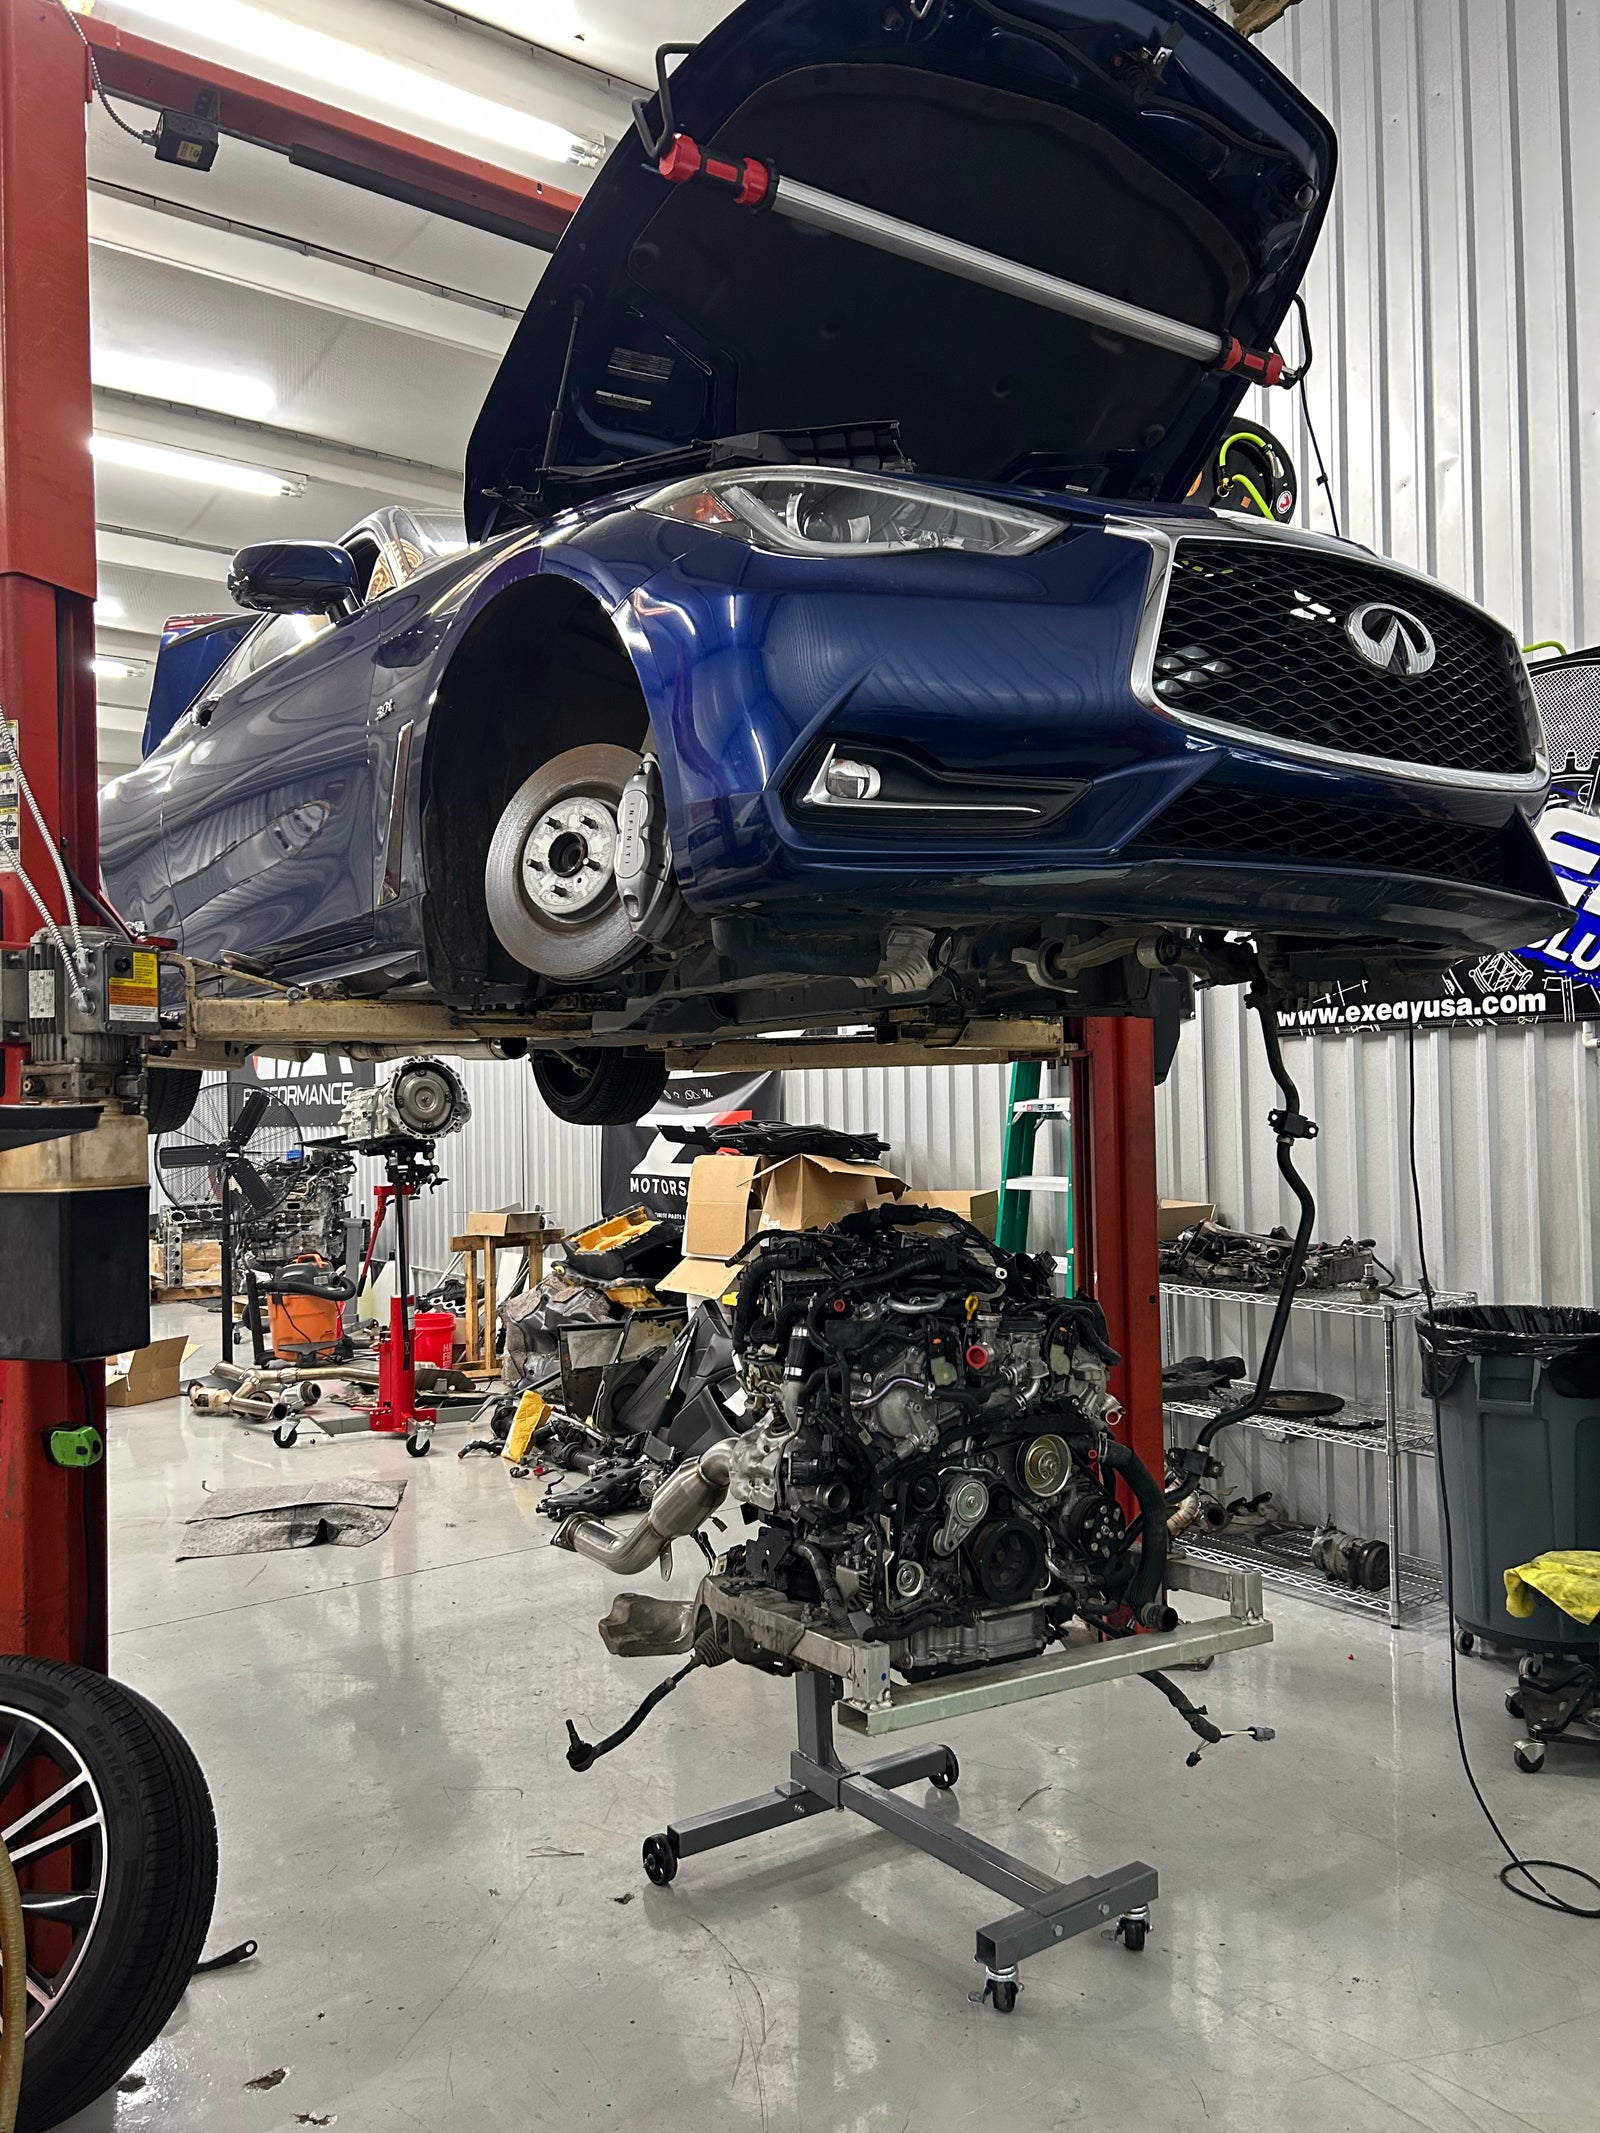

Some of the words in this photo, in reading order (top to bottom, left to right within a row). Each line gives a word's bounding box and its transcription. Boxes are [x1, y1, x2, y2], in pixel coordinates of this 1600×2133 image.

[625, 802, 635, 864] INFINITI
[1527, 928, 1600, 971] LU
[1277, 992, 1547, 1027] www.exedyusa.com
[243, 1081, 354, 1107] PFORMANCE
[630, 1177, 687, 1197] MOTORS
